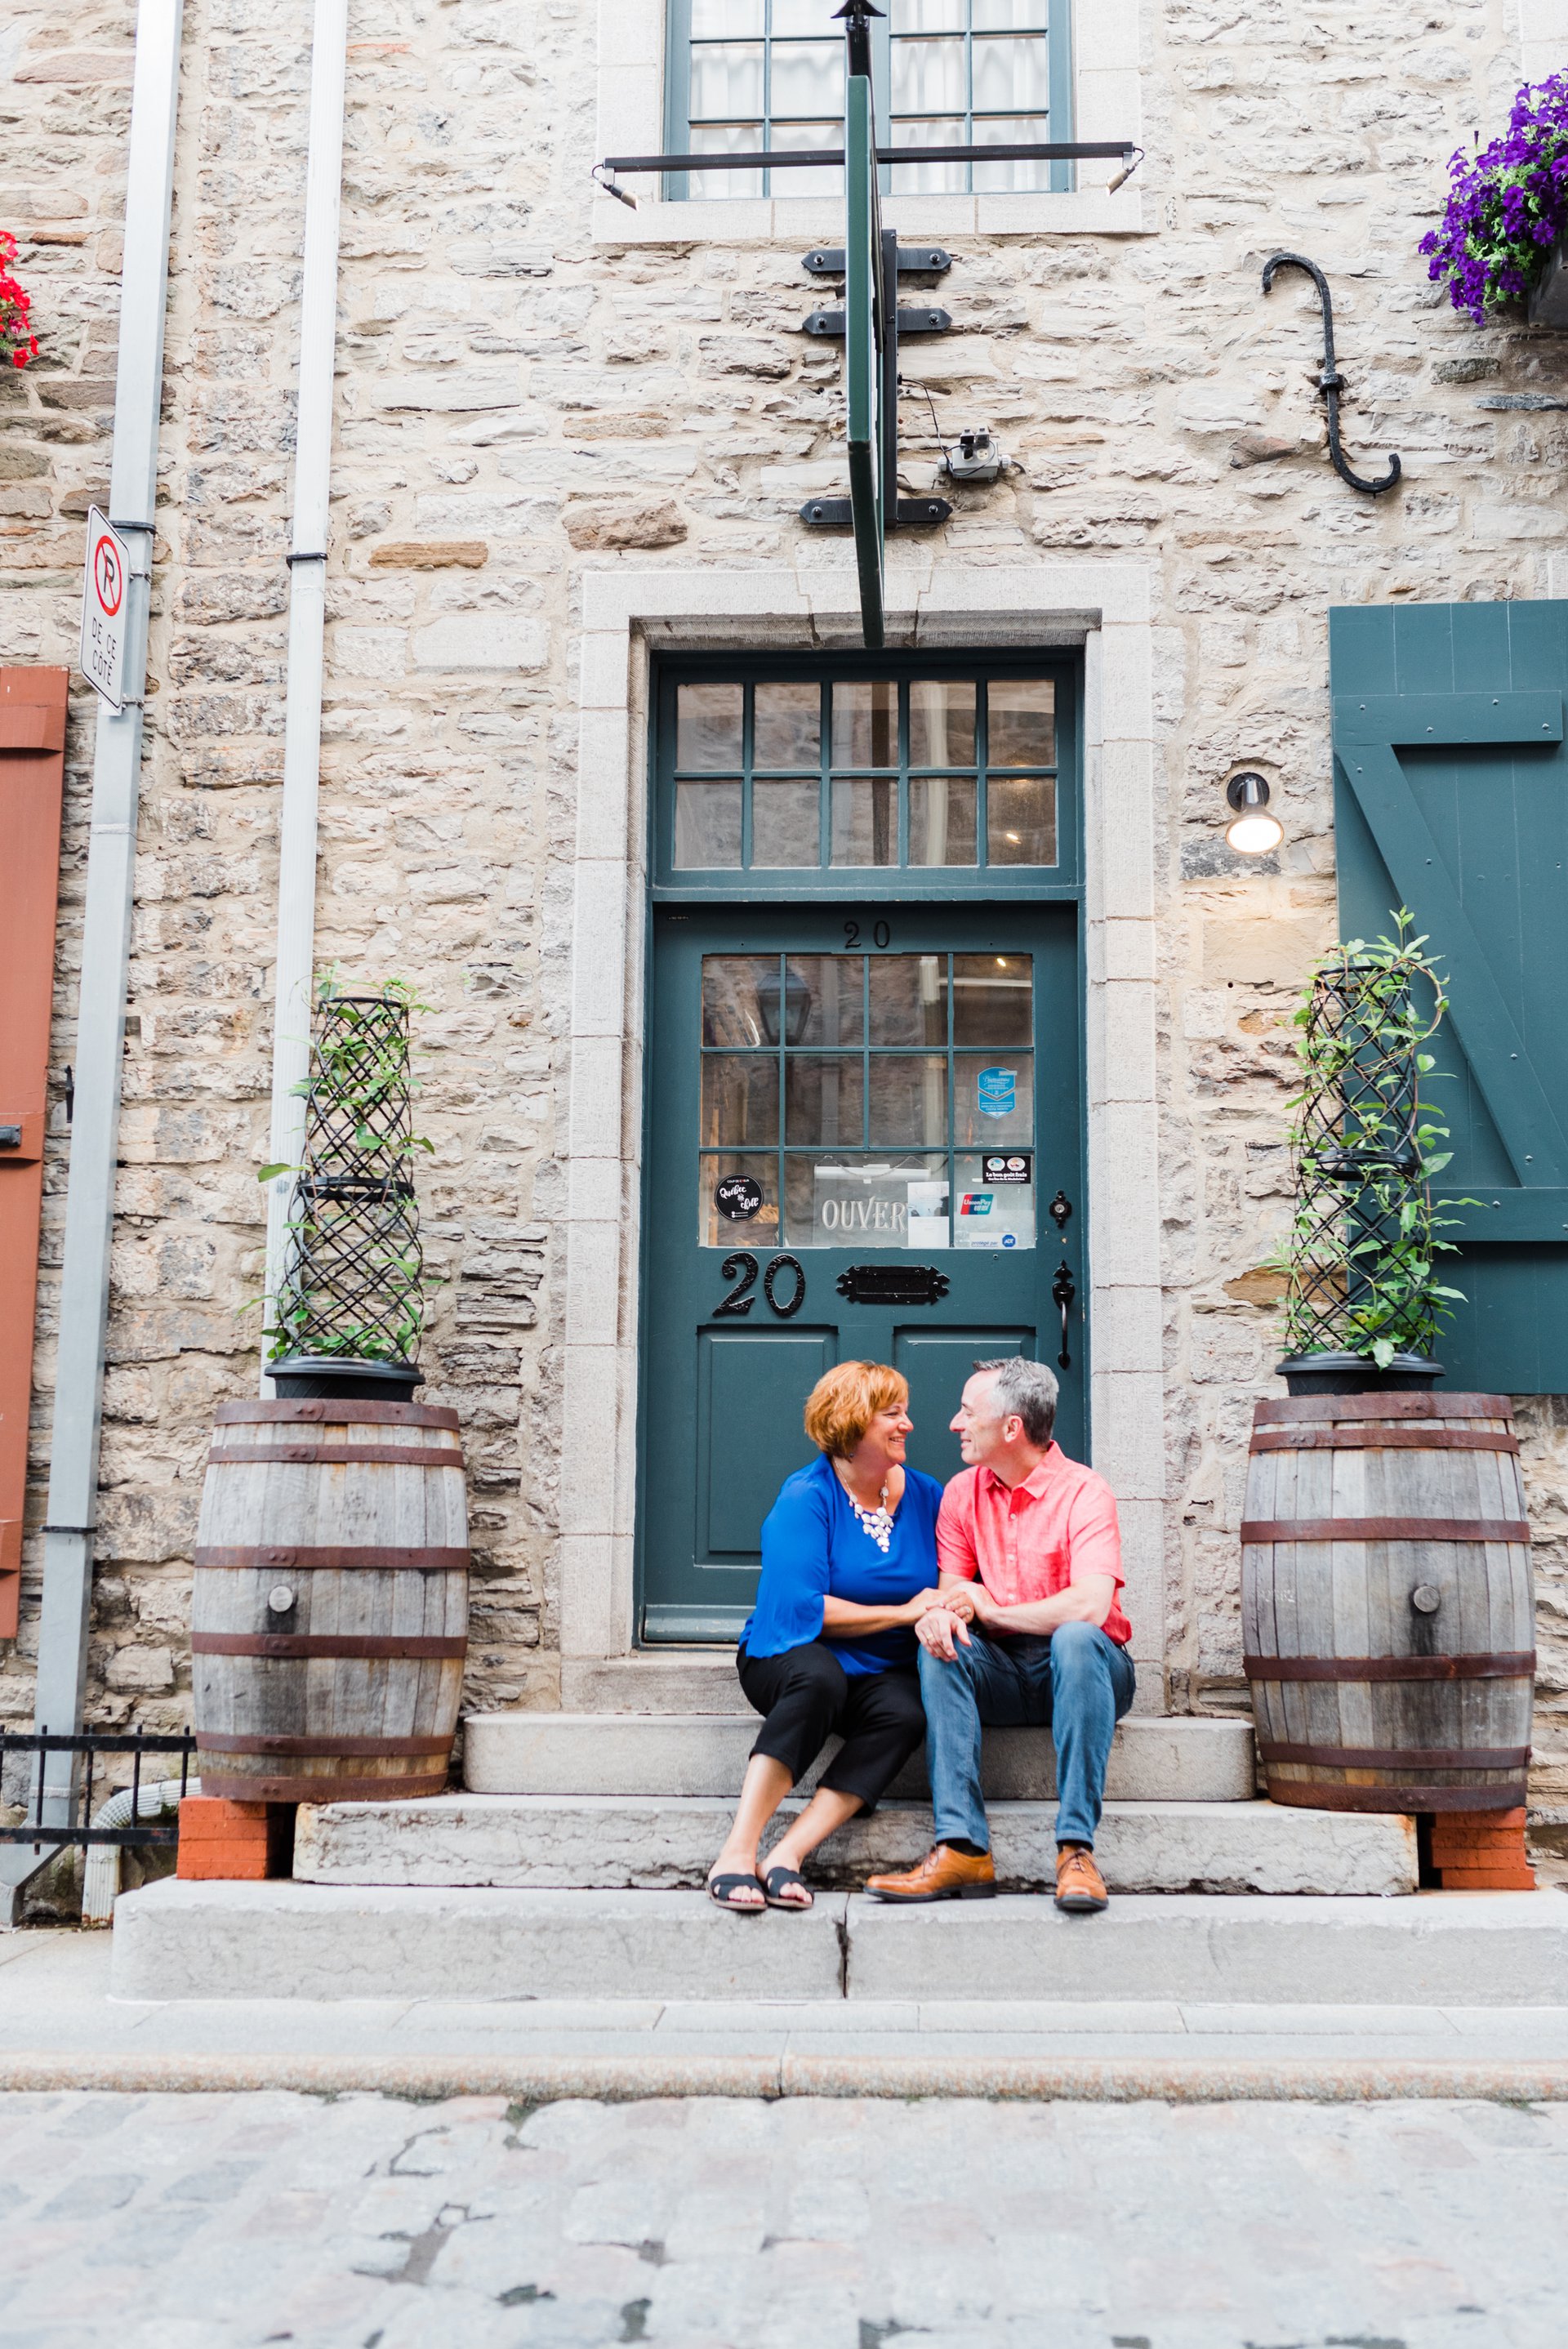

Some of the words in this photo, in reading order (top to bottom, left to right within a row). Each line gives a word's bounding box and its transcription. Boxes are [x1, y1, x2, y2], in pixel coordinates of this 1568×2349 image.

[91, 616, 103, 645] DE
[106, 633, 117, 661] CE
[92, 649, 113, 687] CÔTÉ
[844, 920, 891, 949] 20
[822, 1195, 908, 1234] OUVER
[964, 1198, 991, 1206] UnionPay
[712, 1251, 806, 1318] 20
